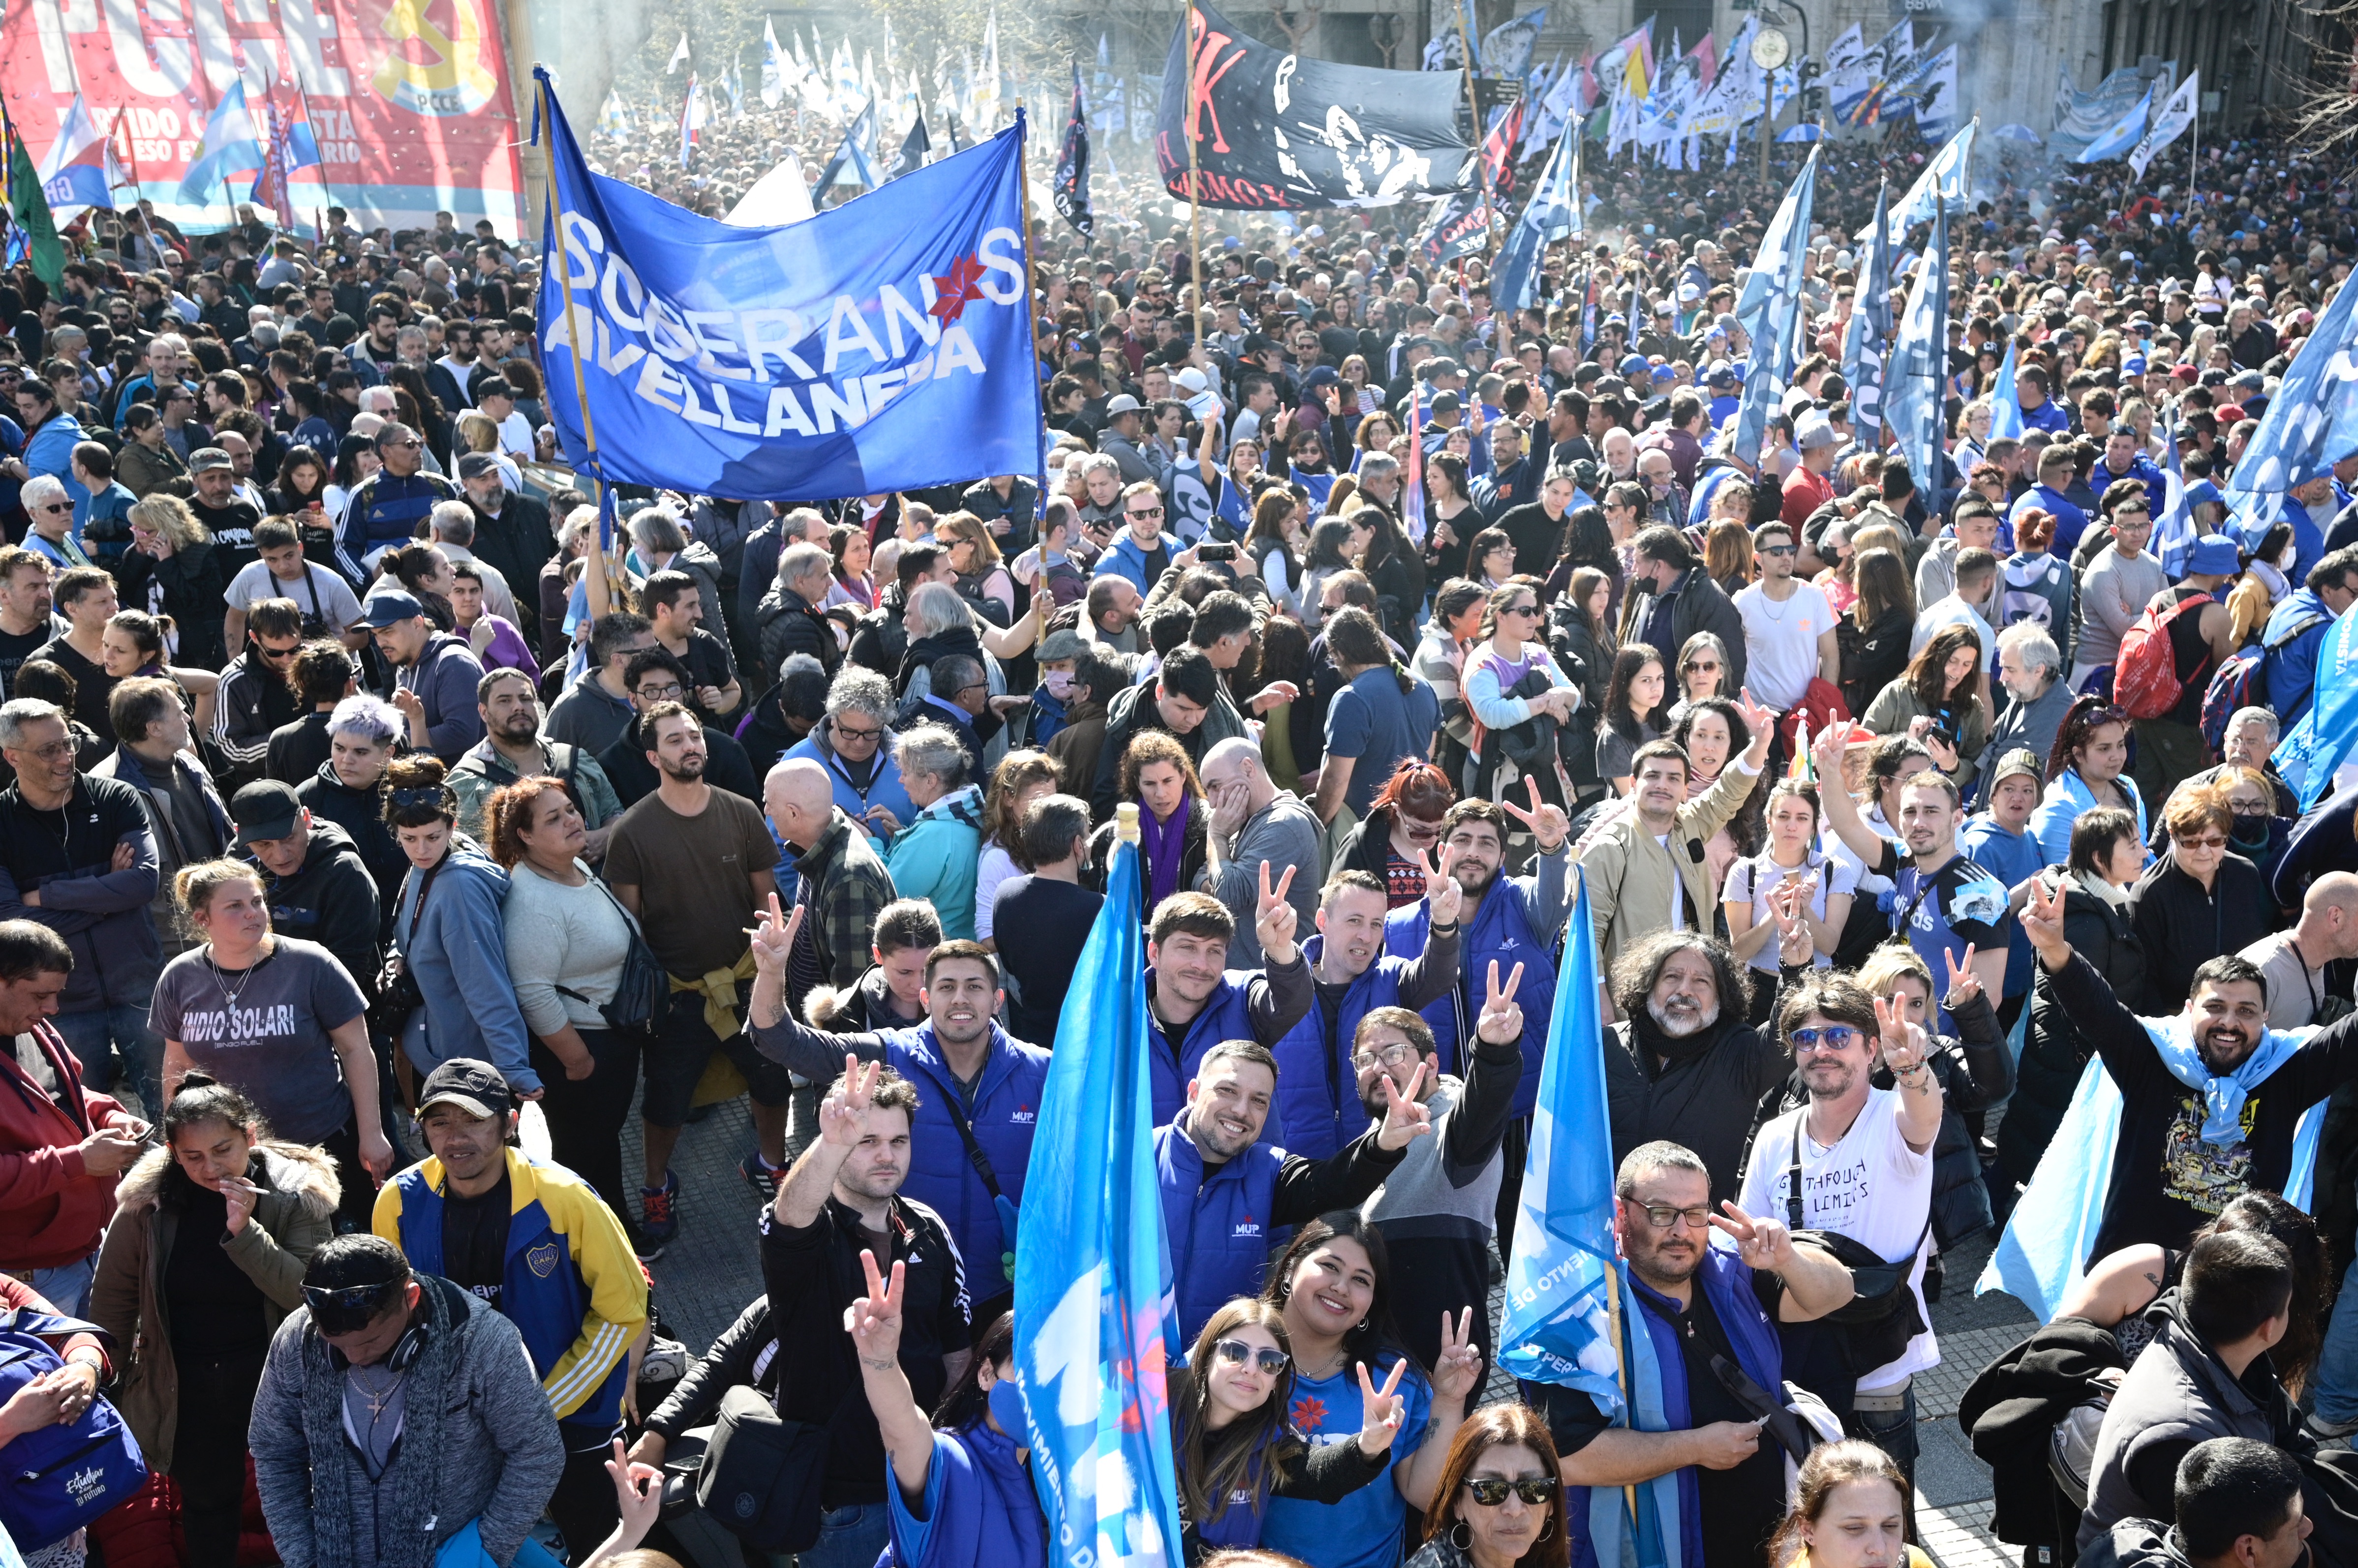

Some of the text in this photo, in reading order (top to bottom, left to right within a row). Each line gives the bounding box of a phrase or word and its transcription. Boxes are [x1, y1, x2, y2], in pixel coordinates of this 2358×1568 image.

[1904, 0, 1944, 10] BBVA
[414, 893, 424, 919] Canon
[183, 1004, 296, 1042] INDIO SOLARI
[1012, 1111, 1034, 1121] MUP
[1235, 1223, 1259, 1234] MUP
[66, 1467, 103, 1494] Estudiar
[75, 1484, 106, 1506] TU FUTURO
